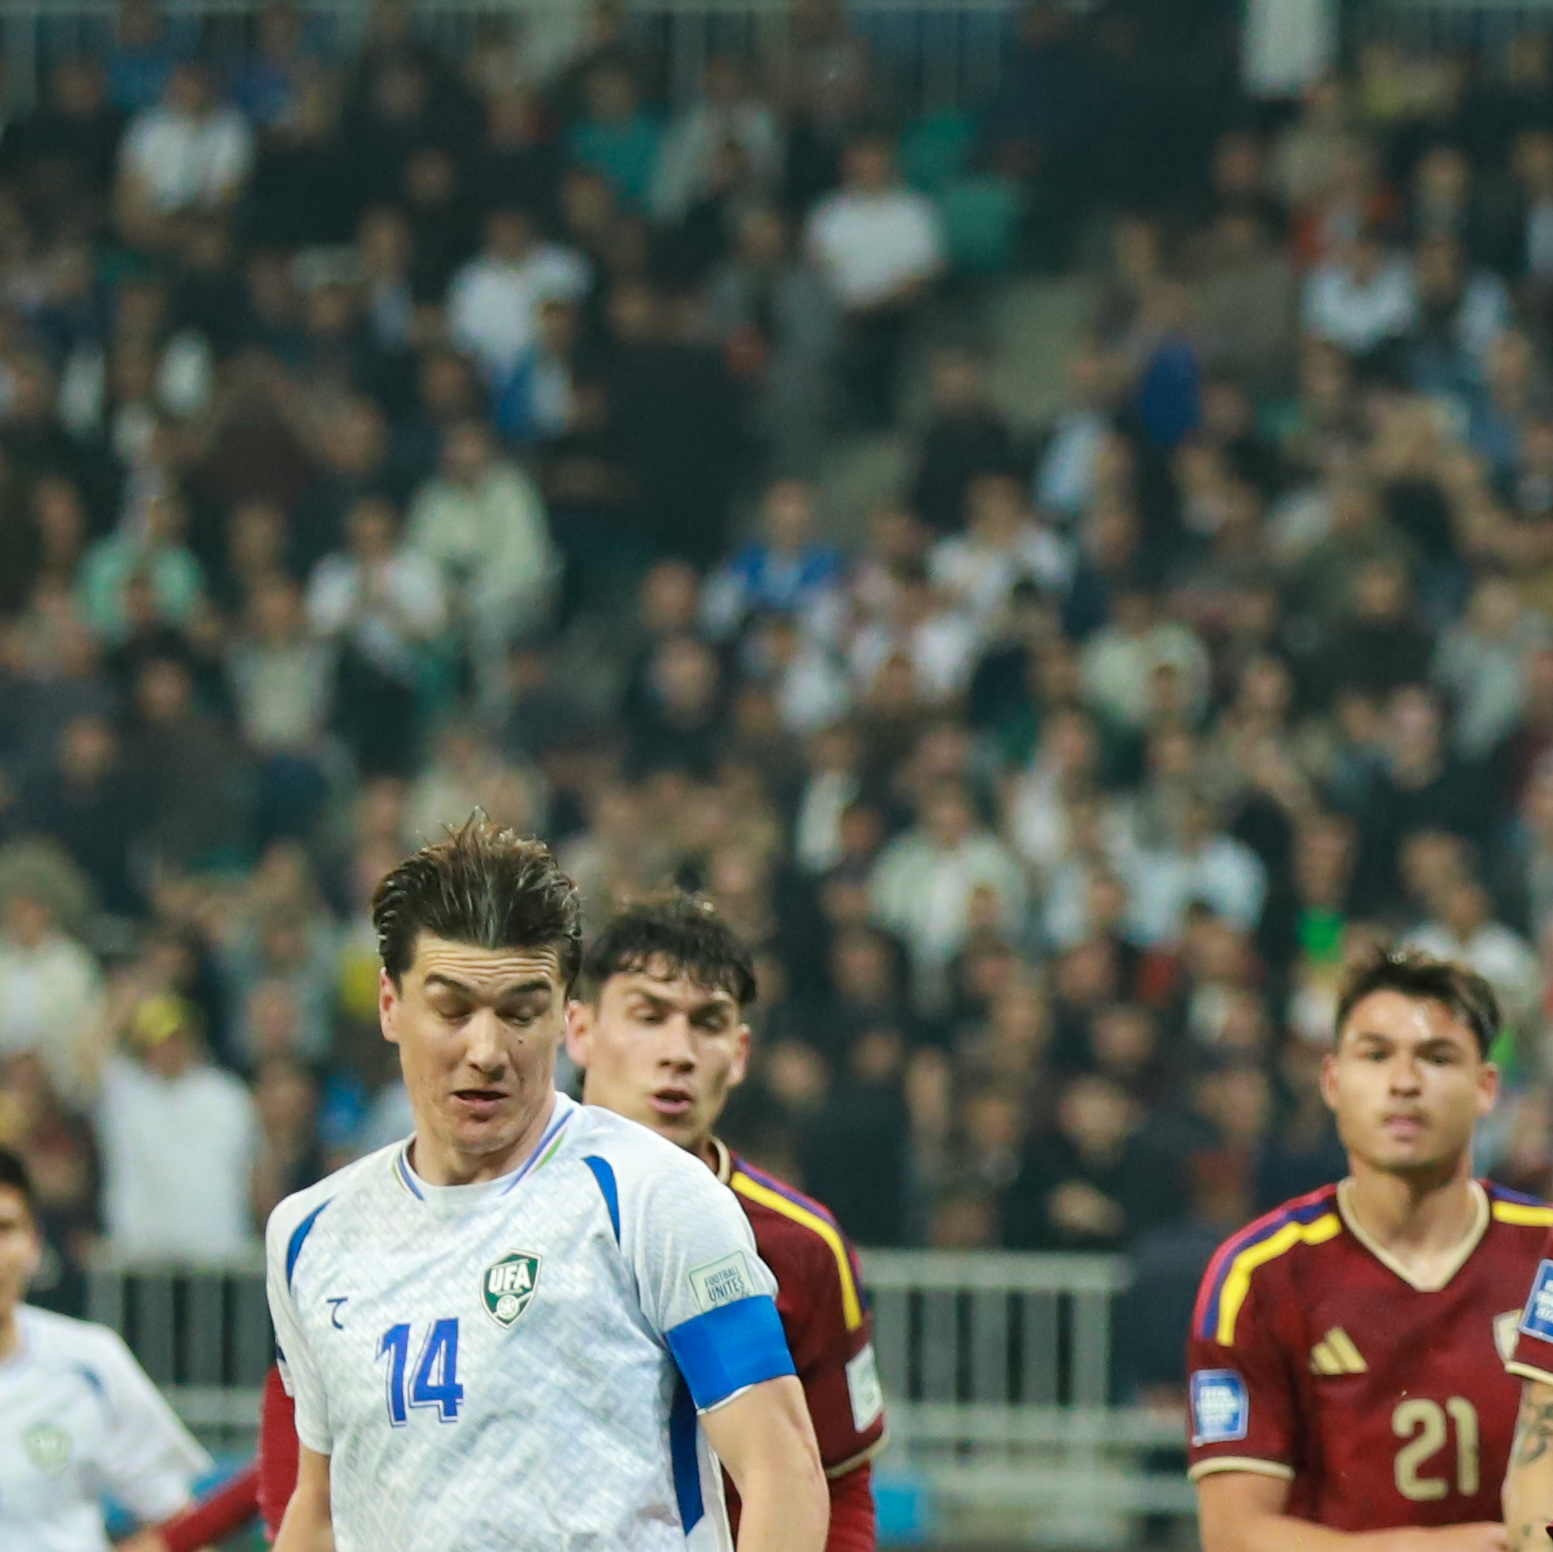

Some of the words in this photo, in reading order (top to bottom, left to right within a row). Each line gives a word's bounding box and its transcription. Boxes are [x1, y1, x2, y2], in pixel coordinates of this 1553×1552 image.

[489, 1261, 531, 1294] UFA
[708, 1276, 745, 1301] UNITES
[374, 1317, 463, 1428] 14
[1392, 1396, 1479, 1501] 21
